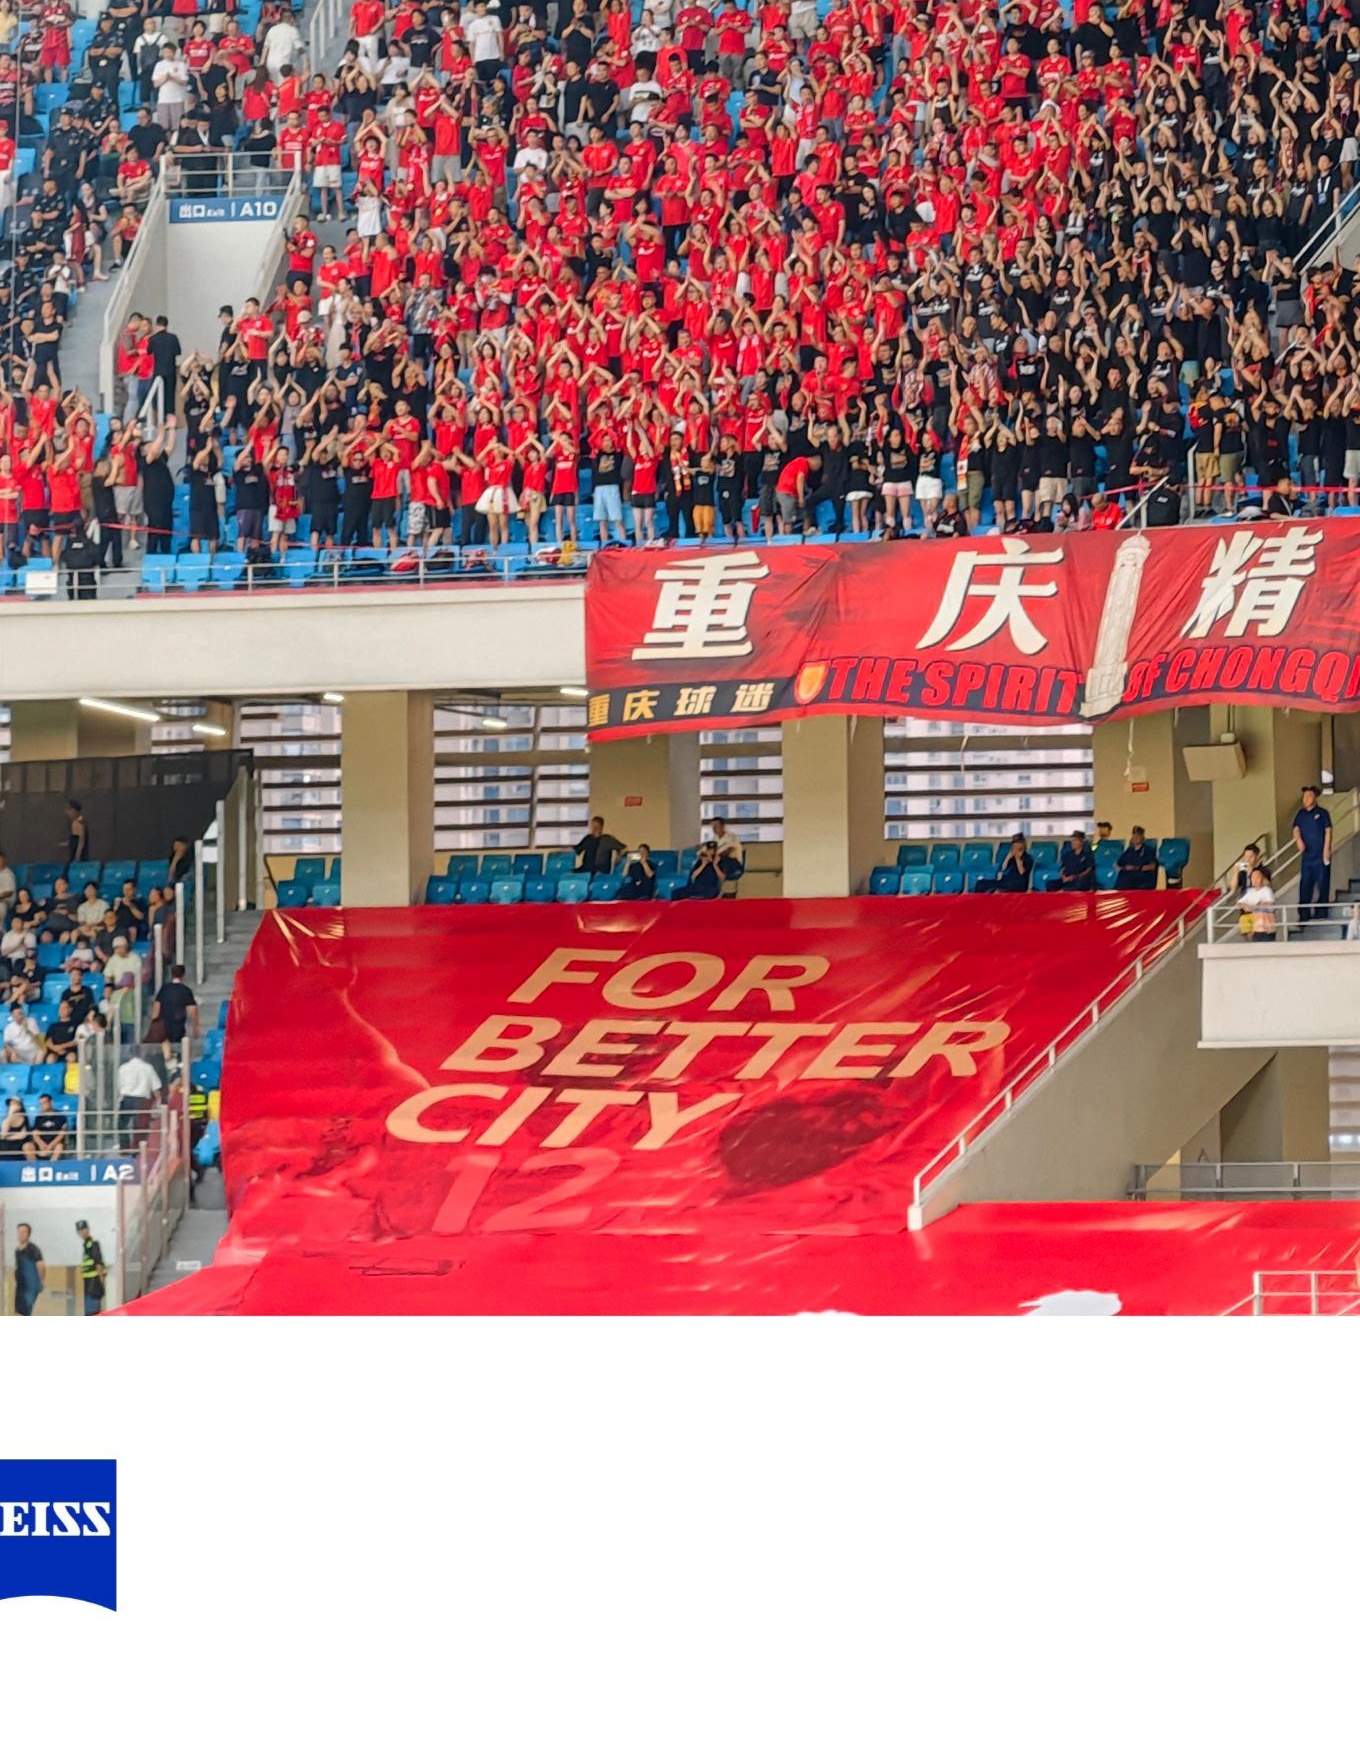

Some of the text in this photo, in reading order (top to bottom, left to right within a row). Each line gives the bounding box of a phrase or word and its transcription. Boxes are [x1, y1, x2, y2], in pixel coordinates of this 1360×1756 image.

[240, 201, 277, 217] A10
[588, 682, 775, 728] 重庆球迷
[826, 657, 918, 704] THE
[920, 660, 1083, 714] SPIRIT
[507, 946, 830, 1012] FOR
[439, 1014, 1011, 1080] BETTER
[385, 1083, 744, 1151] CITY
[103, 1164, 135, 1182] A2
[431, 1147, 620, 1234] 12
